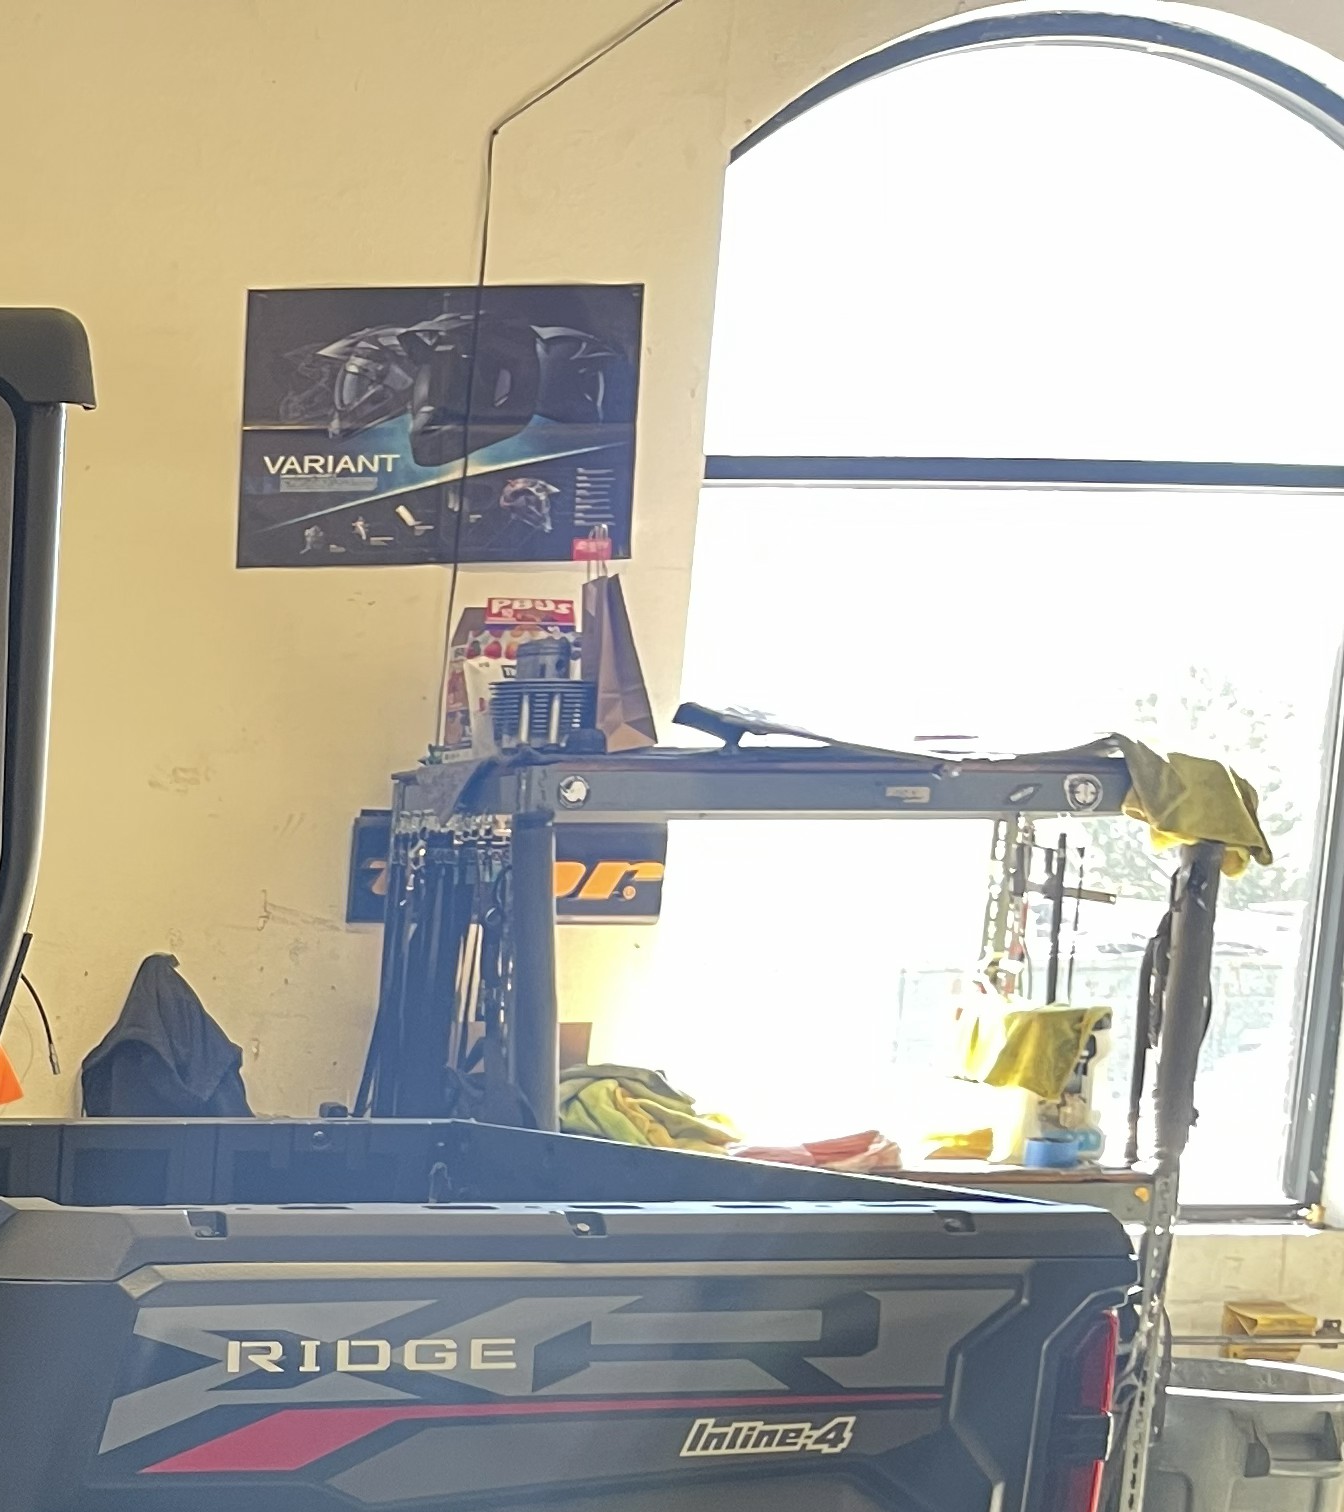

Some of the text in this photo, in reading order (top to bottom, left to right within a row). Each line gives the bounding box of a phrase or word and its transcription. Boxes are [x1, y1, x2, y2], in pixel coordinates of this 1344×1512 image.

[263, 454, 401, 475] VARIANT
[227, 1338, 517, 1373] RIDGE
[679, 1415, 857, 1457] Inline-4
